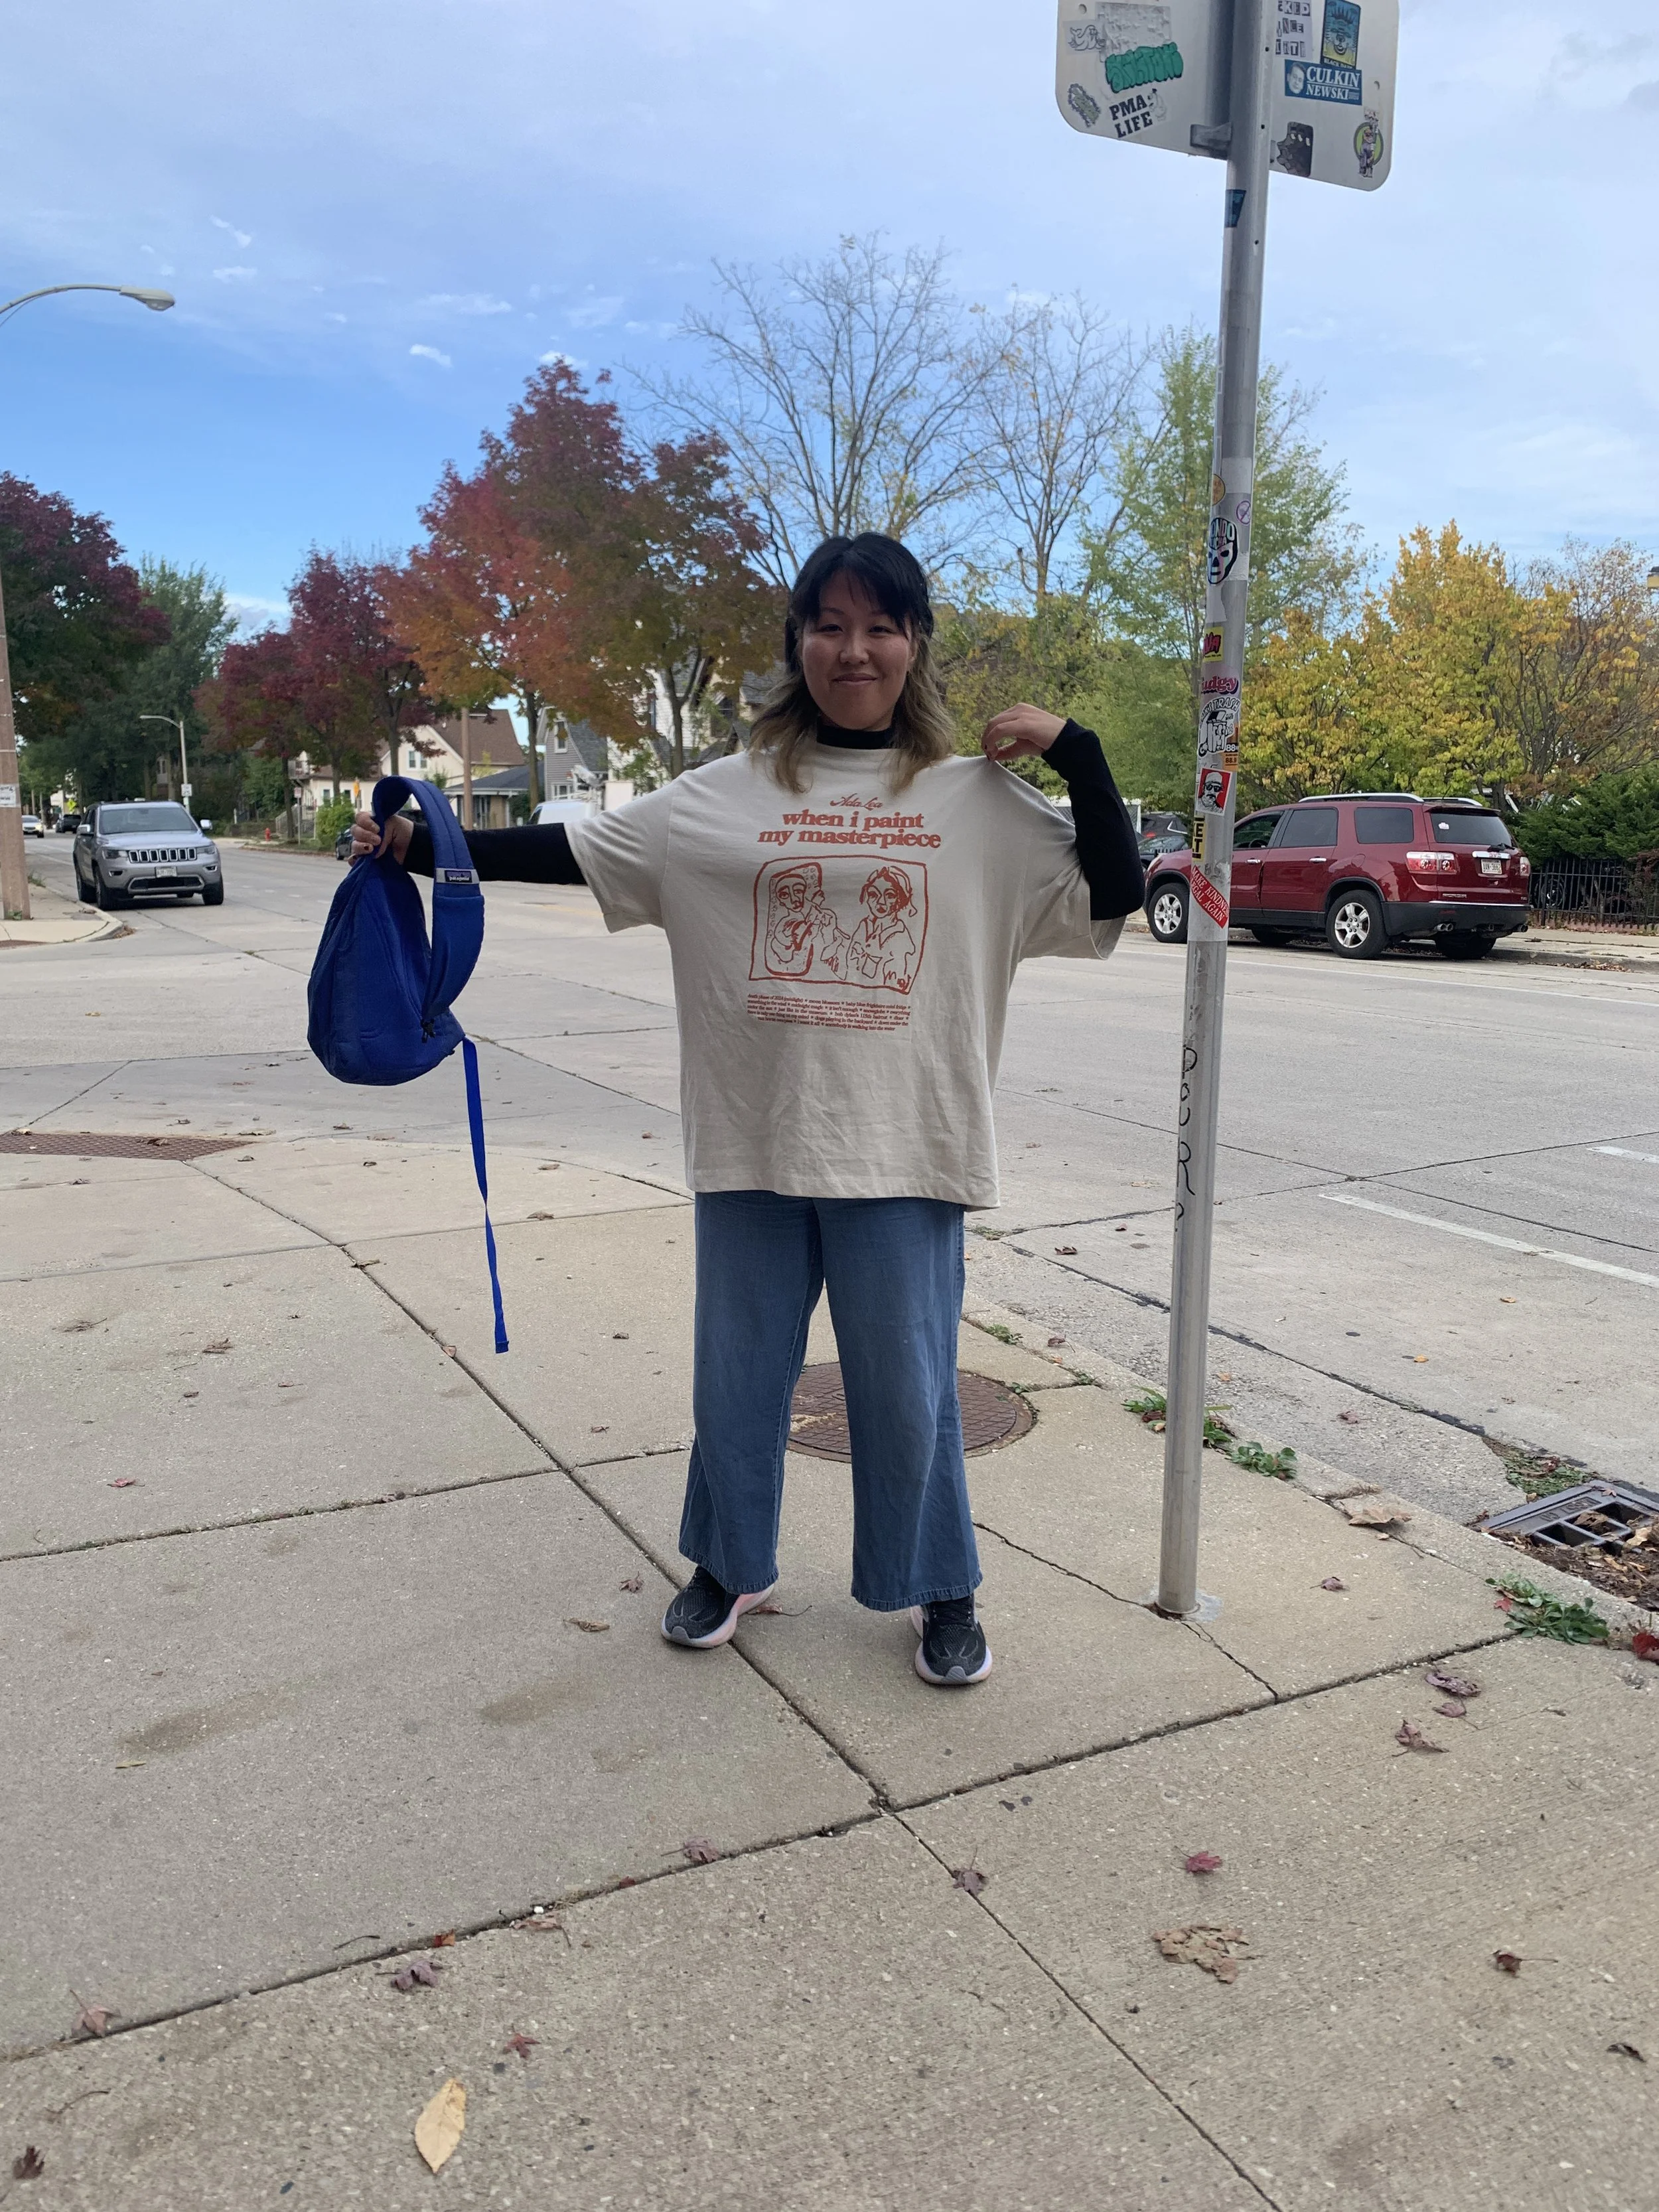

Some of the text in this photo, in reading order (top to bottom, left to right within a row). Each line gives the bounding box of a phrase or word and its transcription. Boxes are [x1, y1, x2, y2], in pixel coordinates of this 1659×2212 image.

[1306, 66, 1360, 87] CULKIN
[1306, 84, 1349, 100] NEWSKI
[1109, 94, 1147, 121] PMA
[1115, 111, 1153, 138] LIFE
[1202, 676, 1239, 694] udgy
[1212, 697, 1240, 712] TRASH
[830, 793, 861, 807] Ada
[782, 808, 924, 832] when i paint
[757, 828, 942, 849] my masterpiece
[1203, 900, 1225, 921] AGAIN
